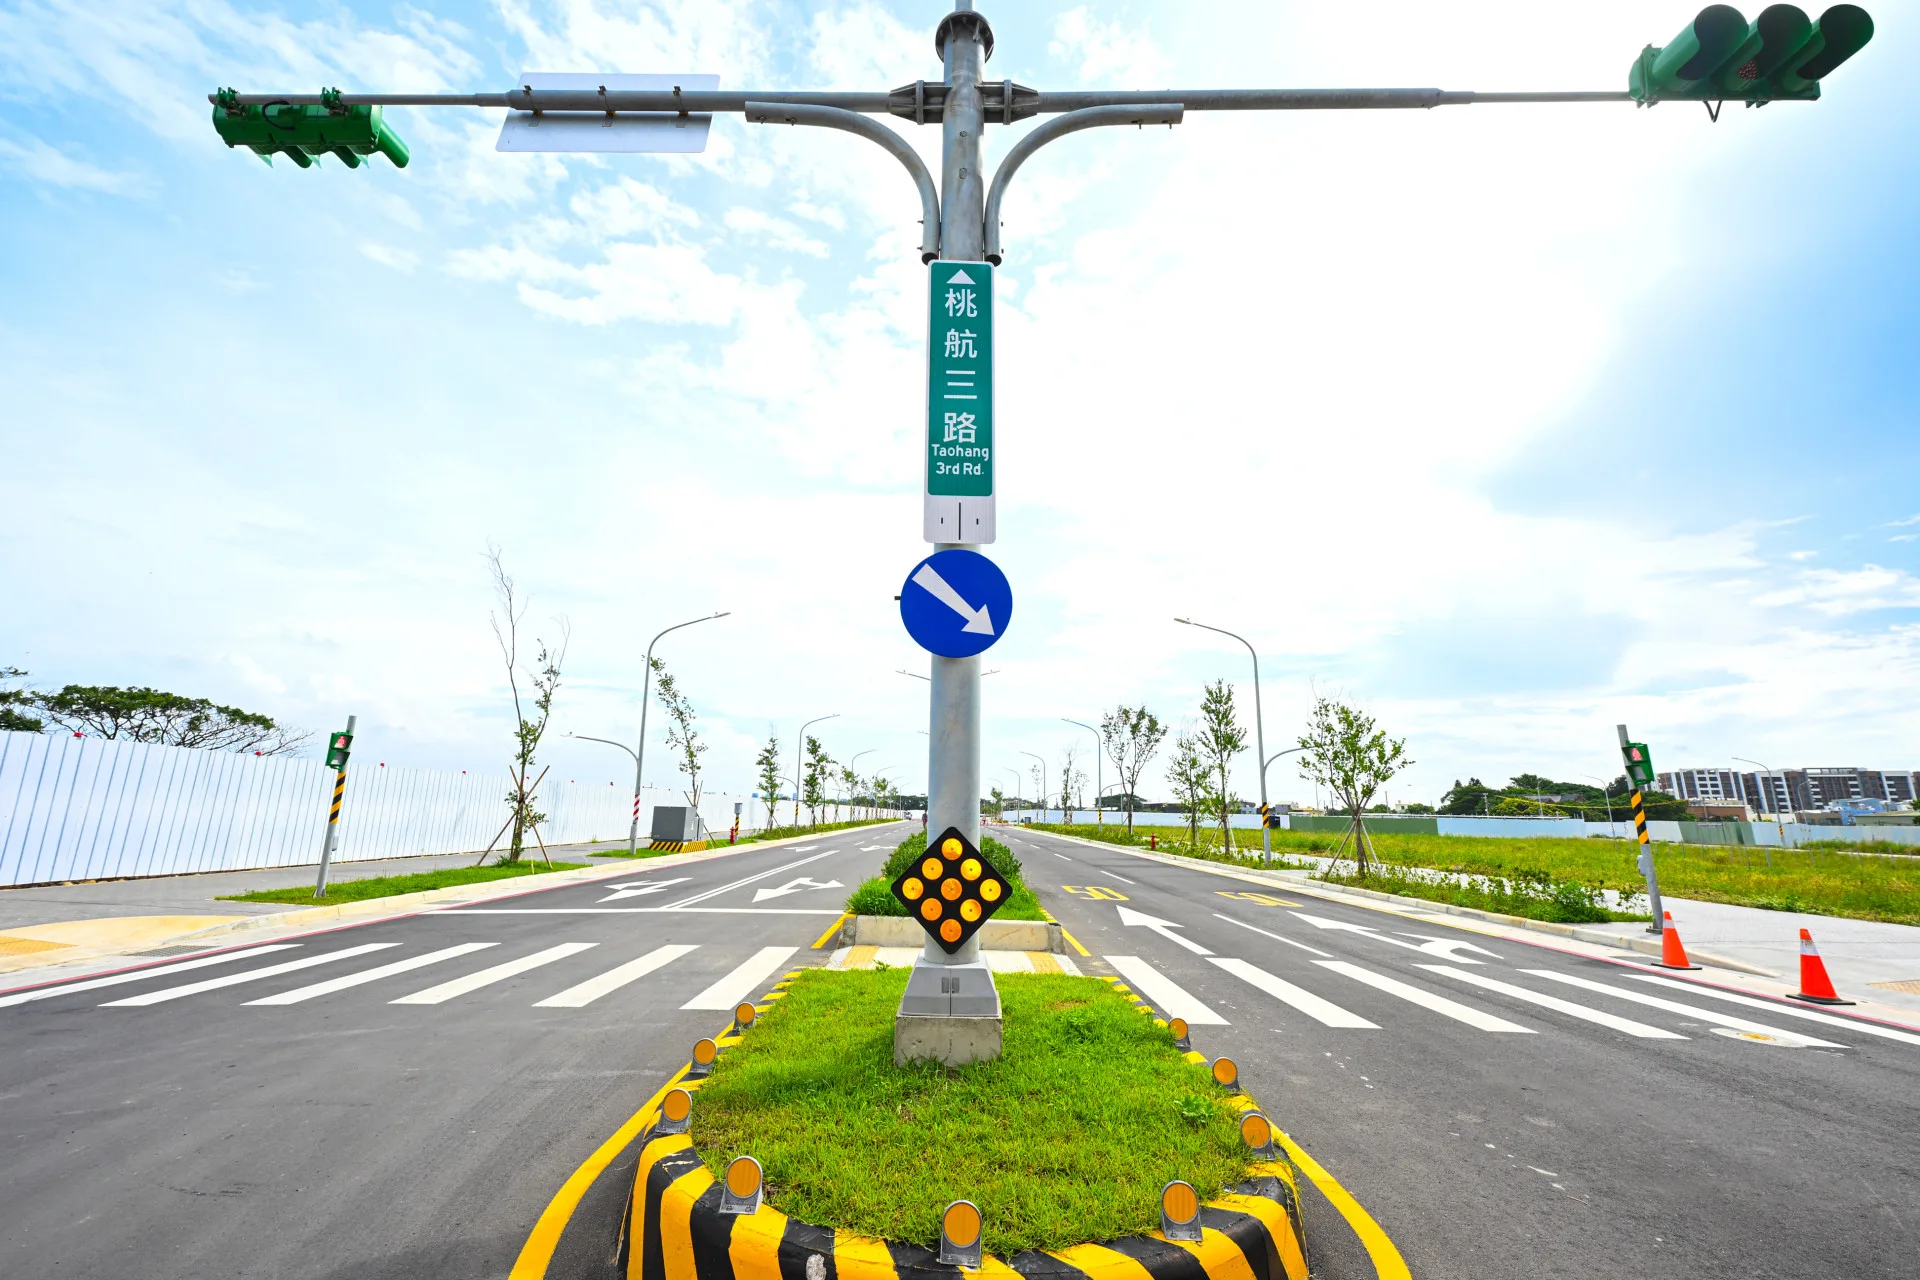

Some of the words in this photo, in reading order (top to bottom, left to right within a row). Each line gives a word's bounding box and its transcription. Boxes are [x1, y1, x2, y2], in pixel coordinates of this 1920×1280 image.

[943, 288, 978, 443] 桃航三路
[931, 444, 989, 461] Taohang
[935, 462, 960, 475] 3rd
[962, 462, 984, 475] Rd.
[1062, 885, 1129, 900] 50
[1214, 891, 1304, 907] 50
